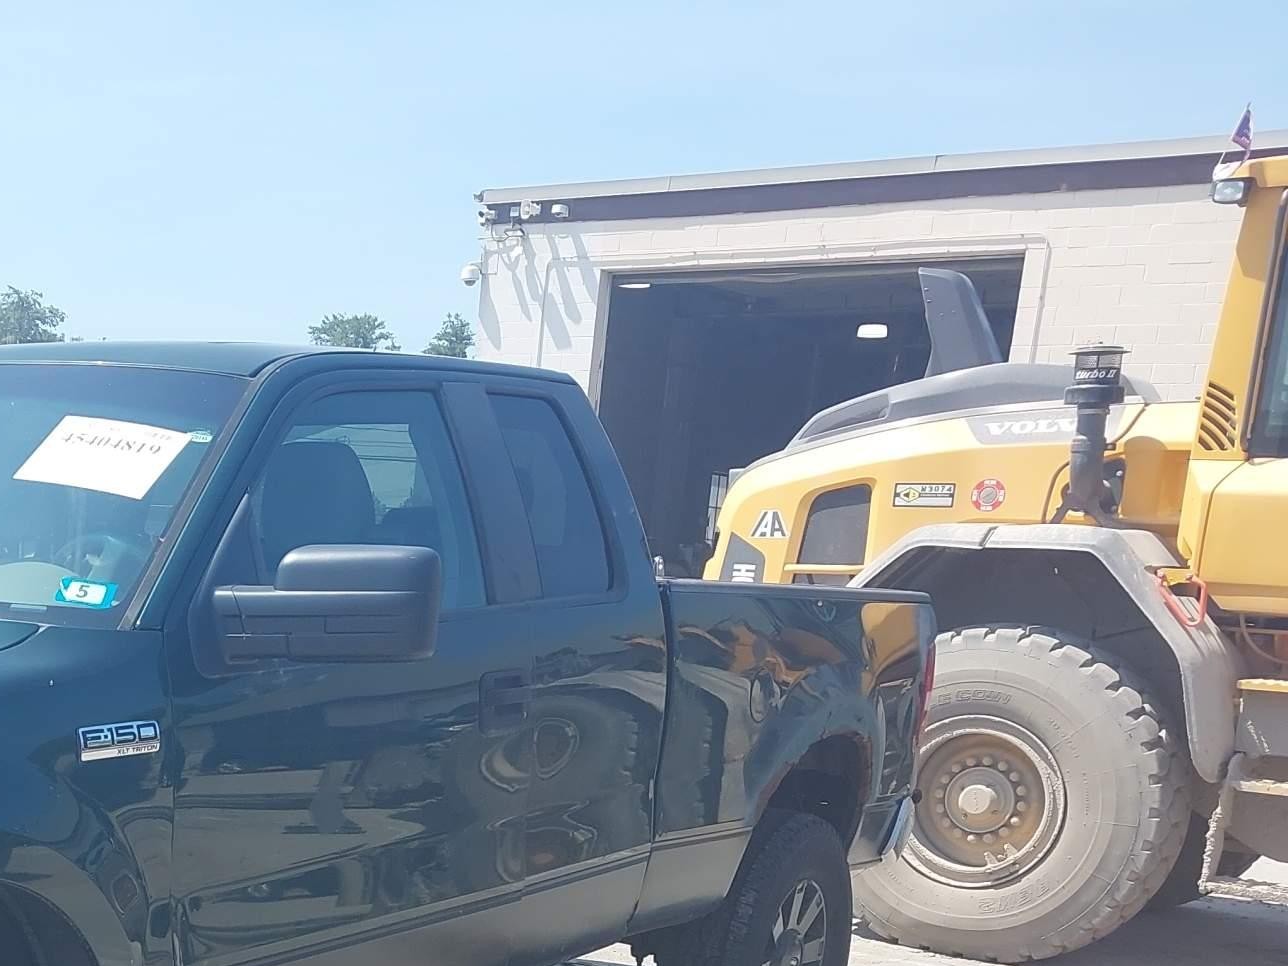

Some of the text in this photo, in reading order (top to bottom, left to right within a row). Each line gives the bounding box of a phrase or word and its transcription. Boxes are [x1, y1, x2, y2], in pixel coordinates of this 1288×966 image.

[1075, 369, 1106, 380] turbo
[983, 419, 1076, 435] VOLV
[75, 584, 90, 598] 5
[117, 744, 158, 756] XLT TRITON
